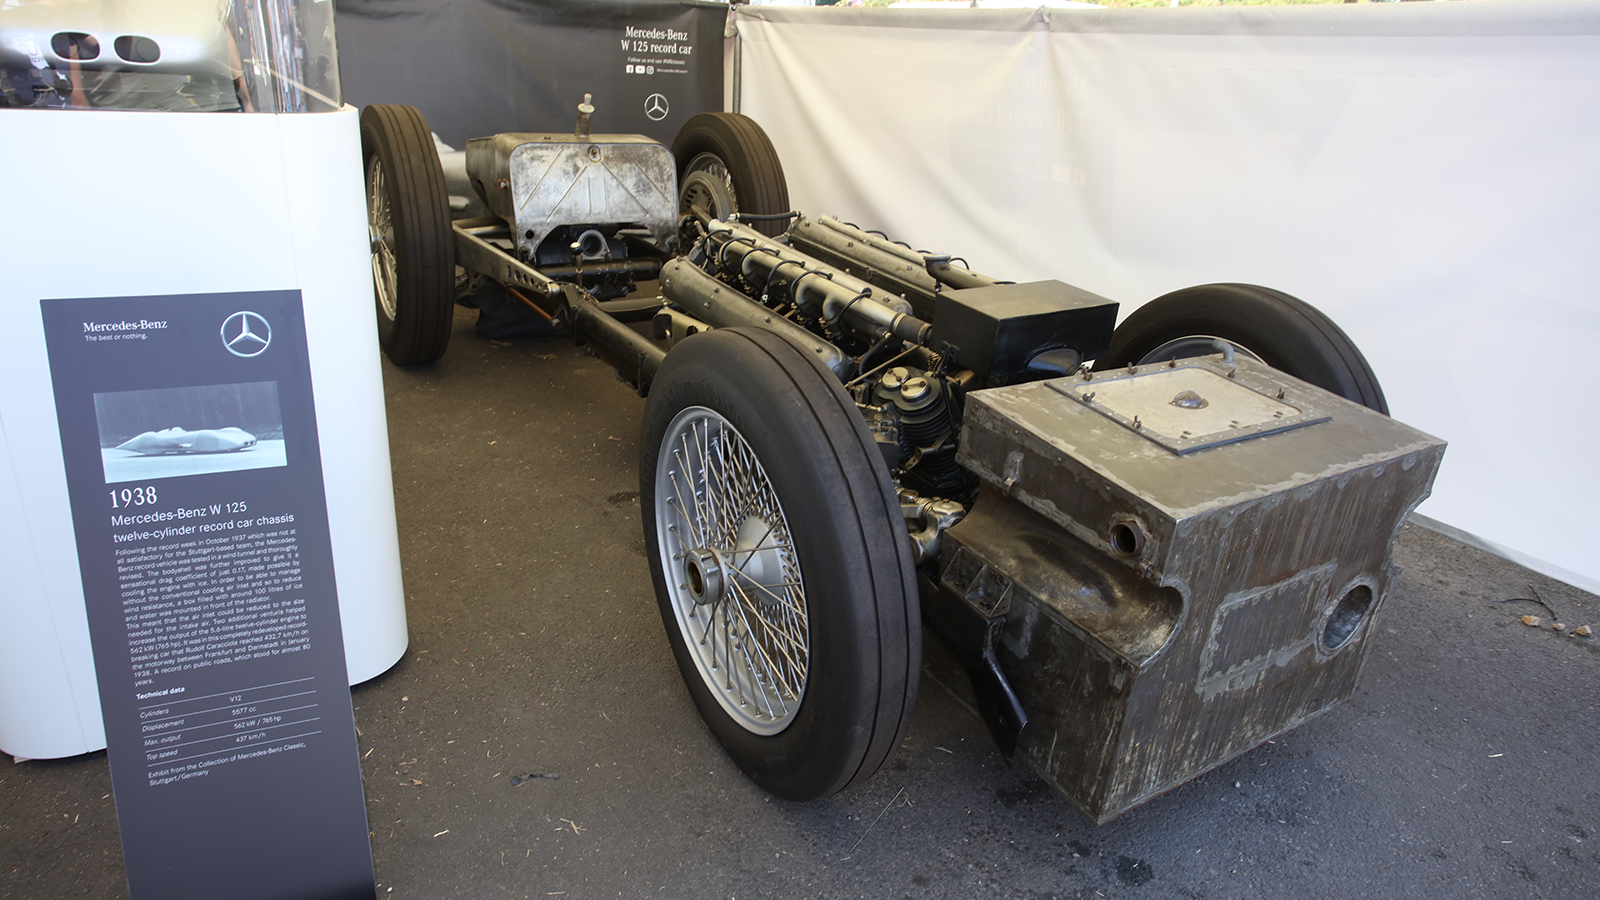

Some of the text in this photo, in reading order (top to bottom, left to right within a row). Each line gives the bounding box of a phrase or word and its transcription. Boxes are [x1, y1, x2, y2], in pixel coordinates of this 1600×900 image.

[626, 26, 688, 40] Mercedes-Benz
[621, 40, 692, 54] W 125 record car
[83, 319, 168, 333] Mercedes-Benz
[662, 376, 746, 430] Silvertown
[110, 486, 157, 508] 1938
[111, 501, 247, 526] Mercedes-Benz W 125
[113, 513, 294, 542] twelve-cylinder record car chassis
[115, 548, 146, 556] Following
[159, 542, 180, 550] record
[126, 554, 163, 563] satisfactory
[188, 544, 235, 555] Stuttgart-based
[120, 578, 156, 589] sensational
[175, 572, 208, 581] coefficient
[218, 569, 230, 577] just
[267, 561, 291, 571] possible
[141, 602, 175, 611] resistance,
[231, 590, 253, 598] around
[127, 628, 153, 638] needed
[228, 613, 258, 623] additional
[260, 610, 284, 618] venturis
[285, 606, 306, 614] helped
[142, 619, 162, 627] meant
[246, 603, 271, 612] reduced
[130, 653, 159, 662] breaking
[185, 645, 205, 653] Rudolf
[206, 640, 238, 650] Caracciola
[239, 636, 263, 645] reached
[145, 659, 176, 668] motorway
[177, 654, 204, 663] between
[204, 649, 233, 658] Frankfurt
[247, 641, 279, 652] Darmstadt
[161, 665, 182, 673] record
[193, 660, 212, 670] public
[234, 654, 252, 662] which
[281, 646, 301, 654] almost
[134, 679, 155, 688] years.
[136, 688, 169, 699] Technical
[139, 709, 170, 719] Cylinders
[231, 707, 248, 715] 5577
[141, 719, 185, 732] Displacement
[161, 734, 182, 743] output
[248, 732, 267, 740] km/h
[148, 768, 170, 778] Exhibit
[198, 758, 229, 768] Collection
[237, 747, 283, 760] Mercedes-Benz
[283, 742, 306, 751] Classic,
[159, 749, 178, 759] speed
[149, 770, 210, 786] Stuttgart/Germany
